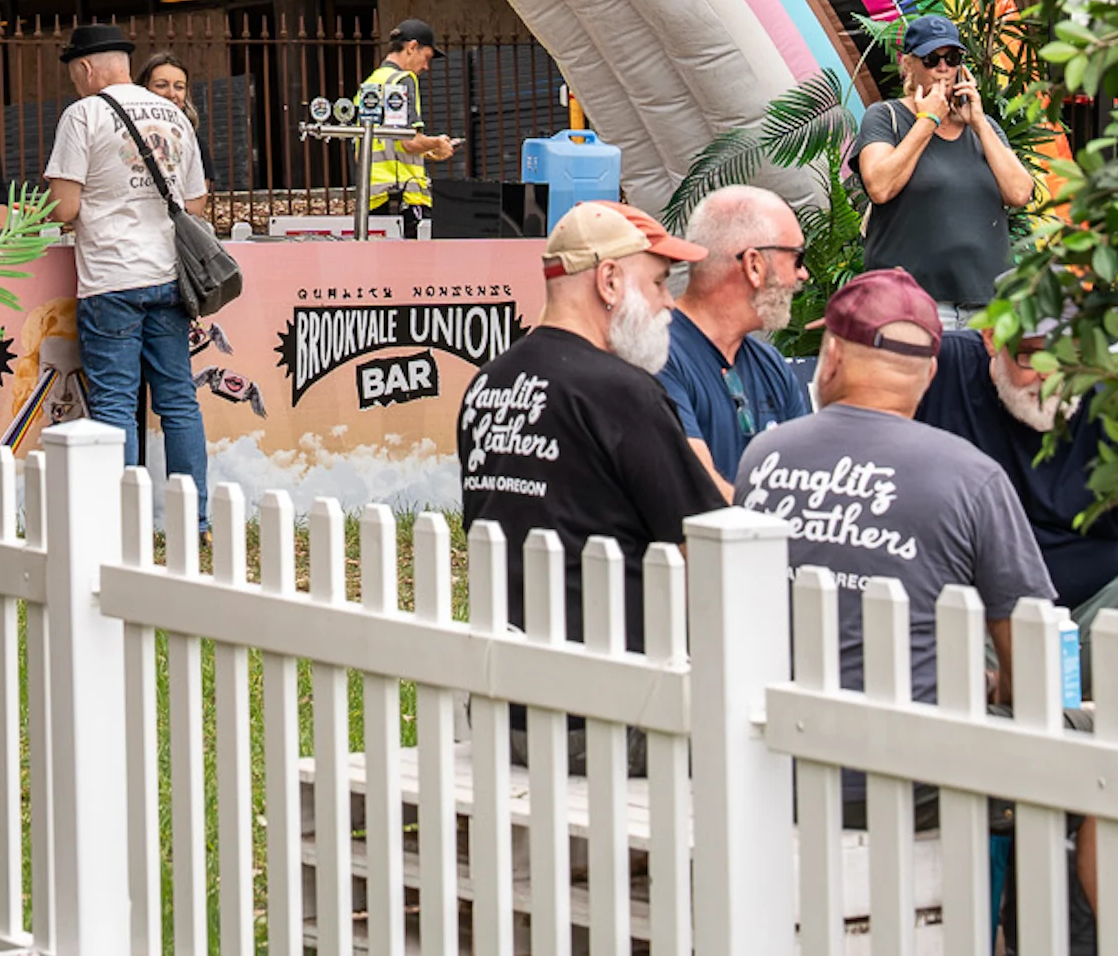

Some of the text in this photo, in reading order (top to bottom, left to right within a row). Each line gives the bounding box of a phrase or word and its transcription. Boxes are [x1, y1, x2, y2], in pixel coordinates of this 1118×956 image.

[296, 305, 512, 391] BROOKVALE UNION
[361, 358, 433, 400] BAR
[468, 412, 560, 472] Leathers
[496, 476, 547, 497] OREGON
[744, 451, 898, 516] Langlitz
